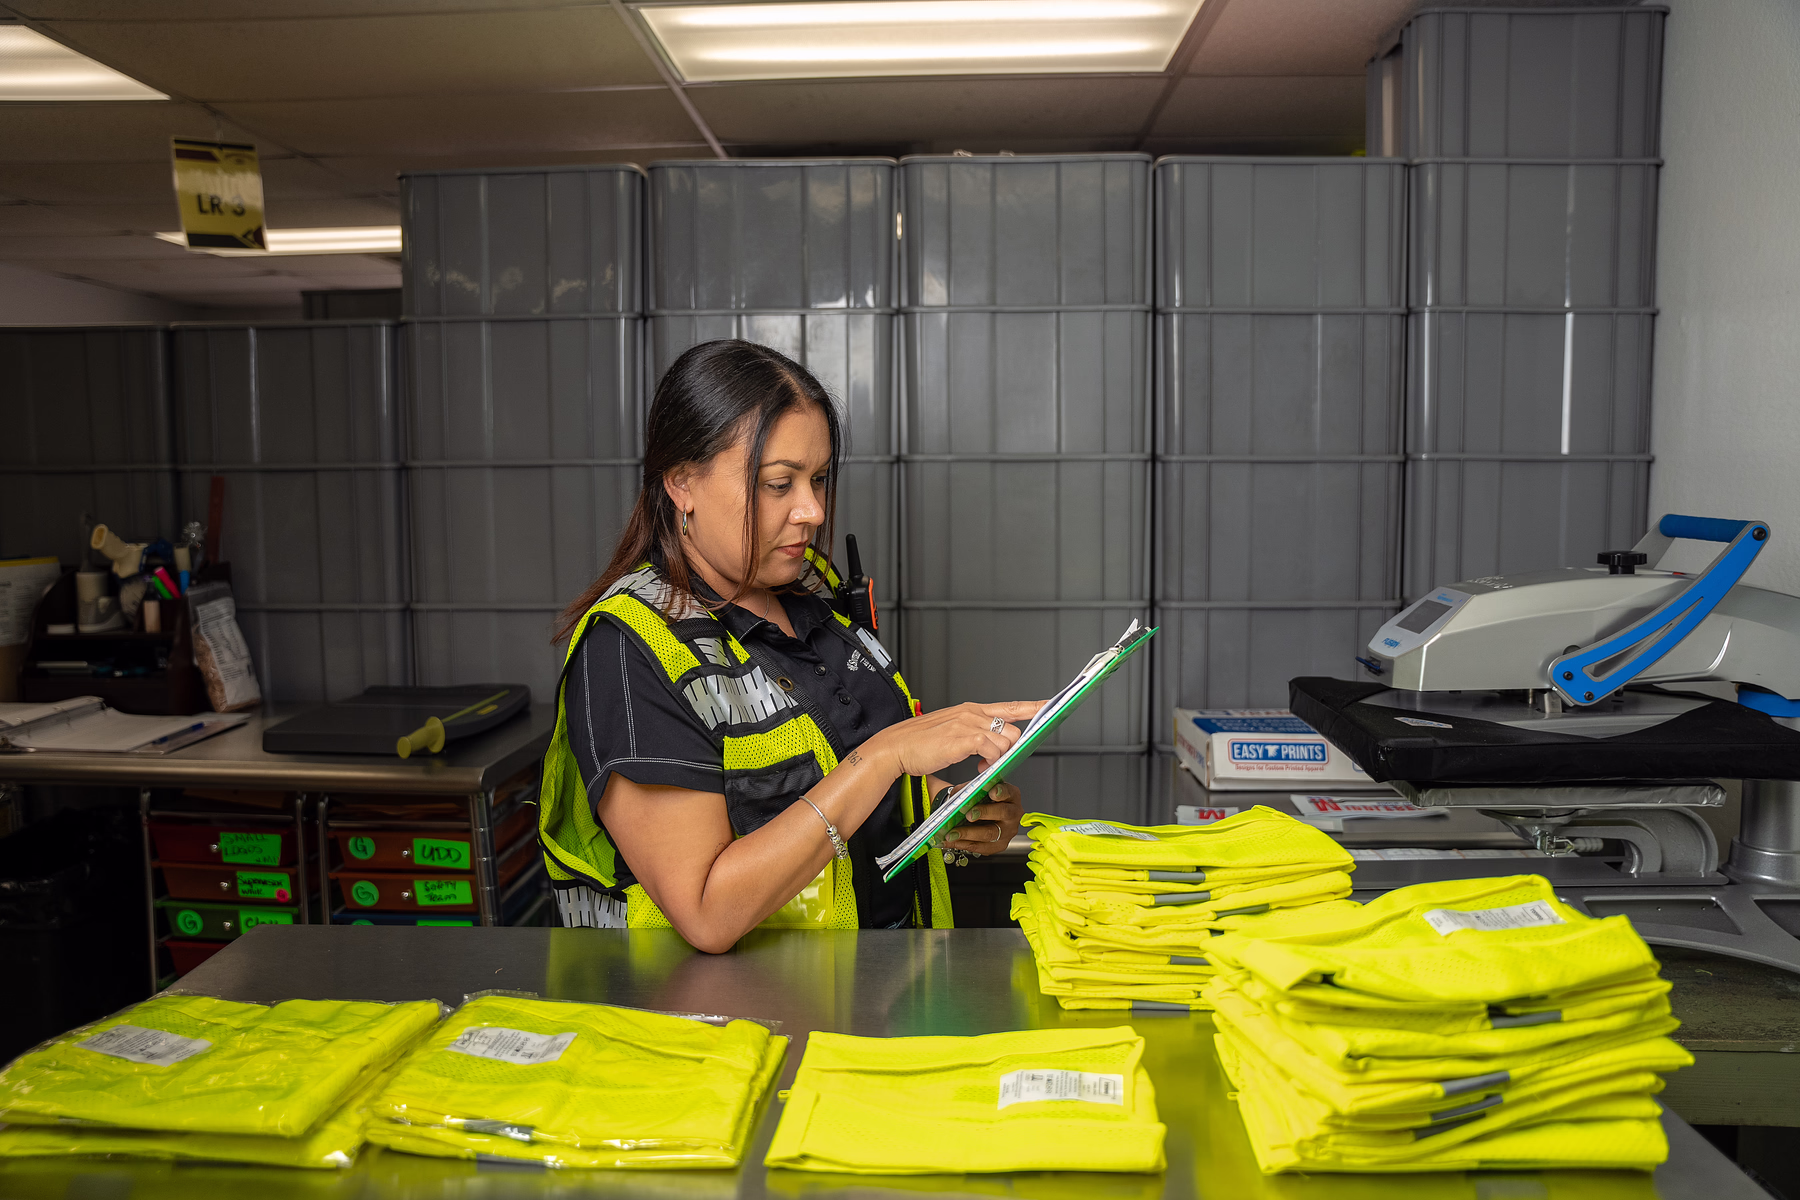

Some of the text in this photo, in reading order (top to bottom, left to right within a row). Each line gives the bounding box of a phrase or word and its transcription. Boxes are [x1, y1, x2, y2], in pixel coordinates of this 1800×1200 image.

[197, 193, 246, 217] LR 3
[1233, 743, 1323, 760] EASY PRINTS
[354, 836, 368, 856] G
[355, 885, 375, 901] G
[183, 913, 198, 931] G
